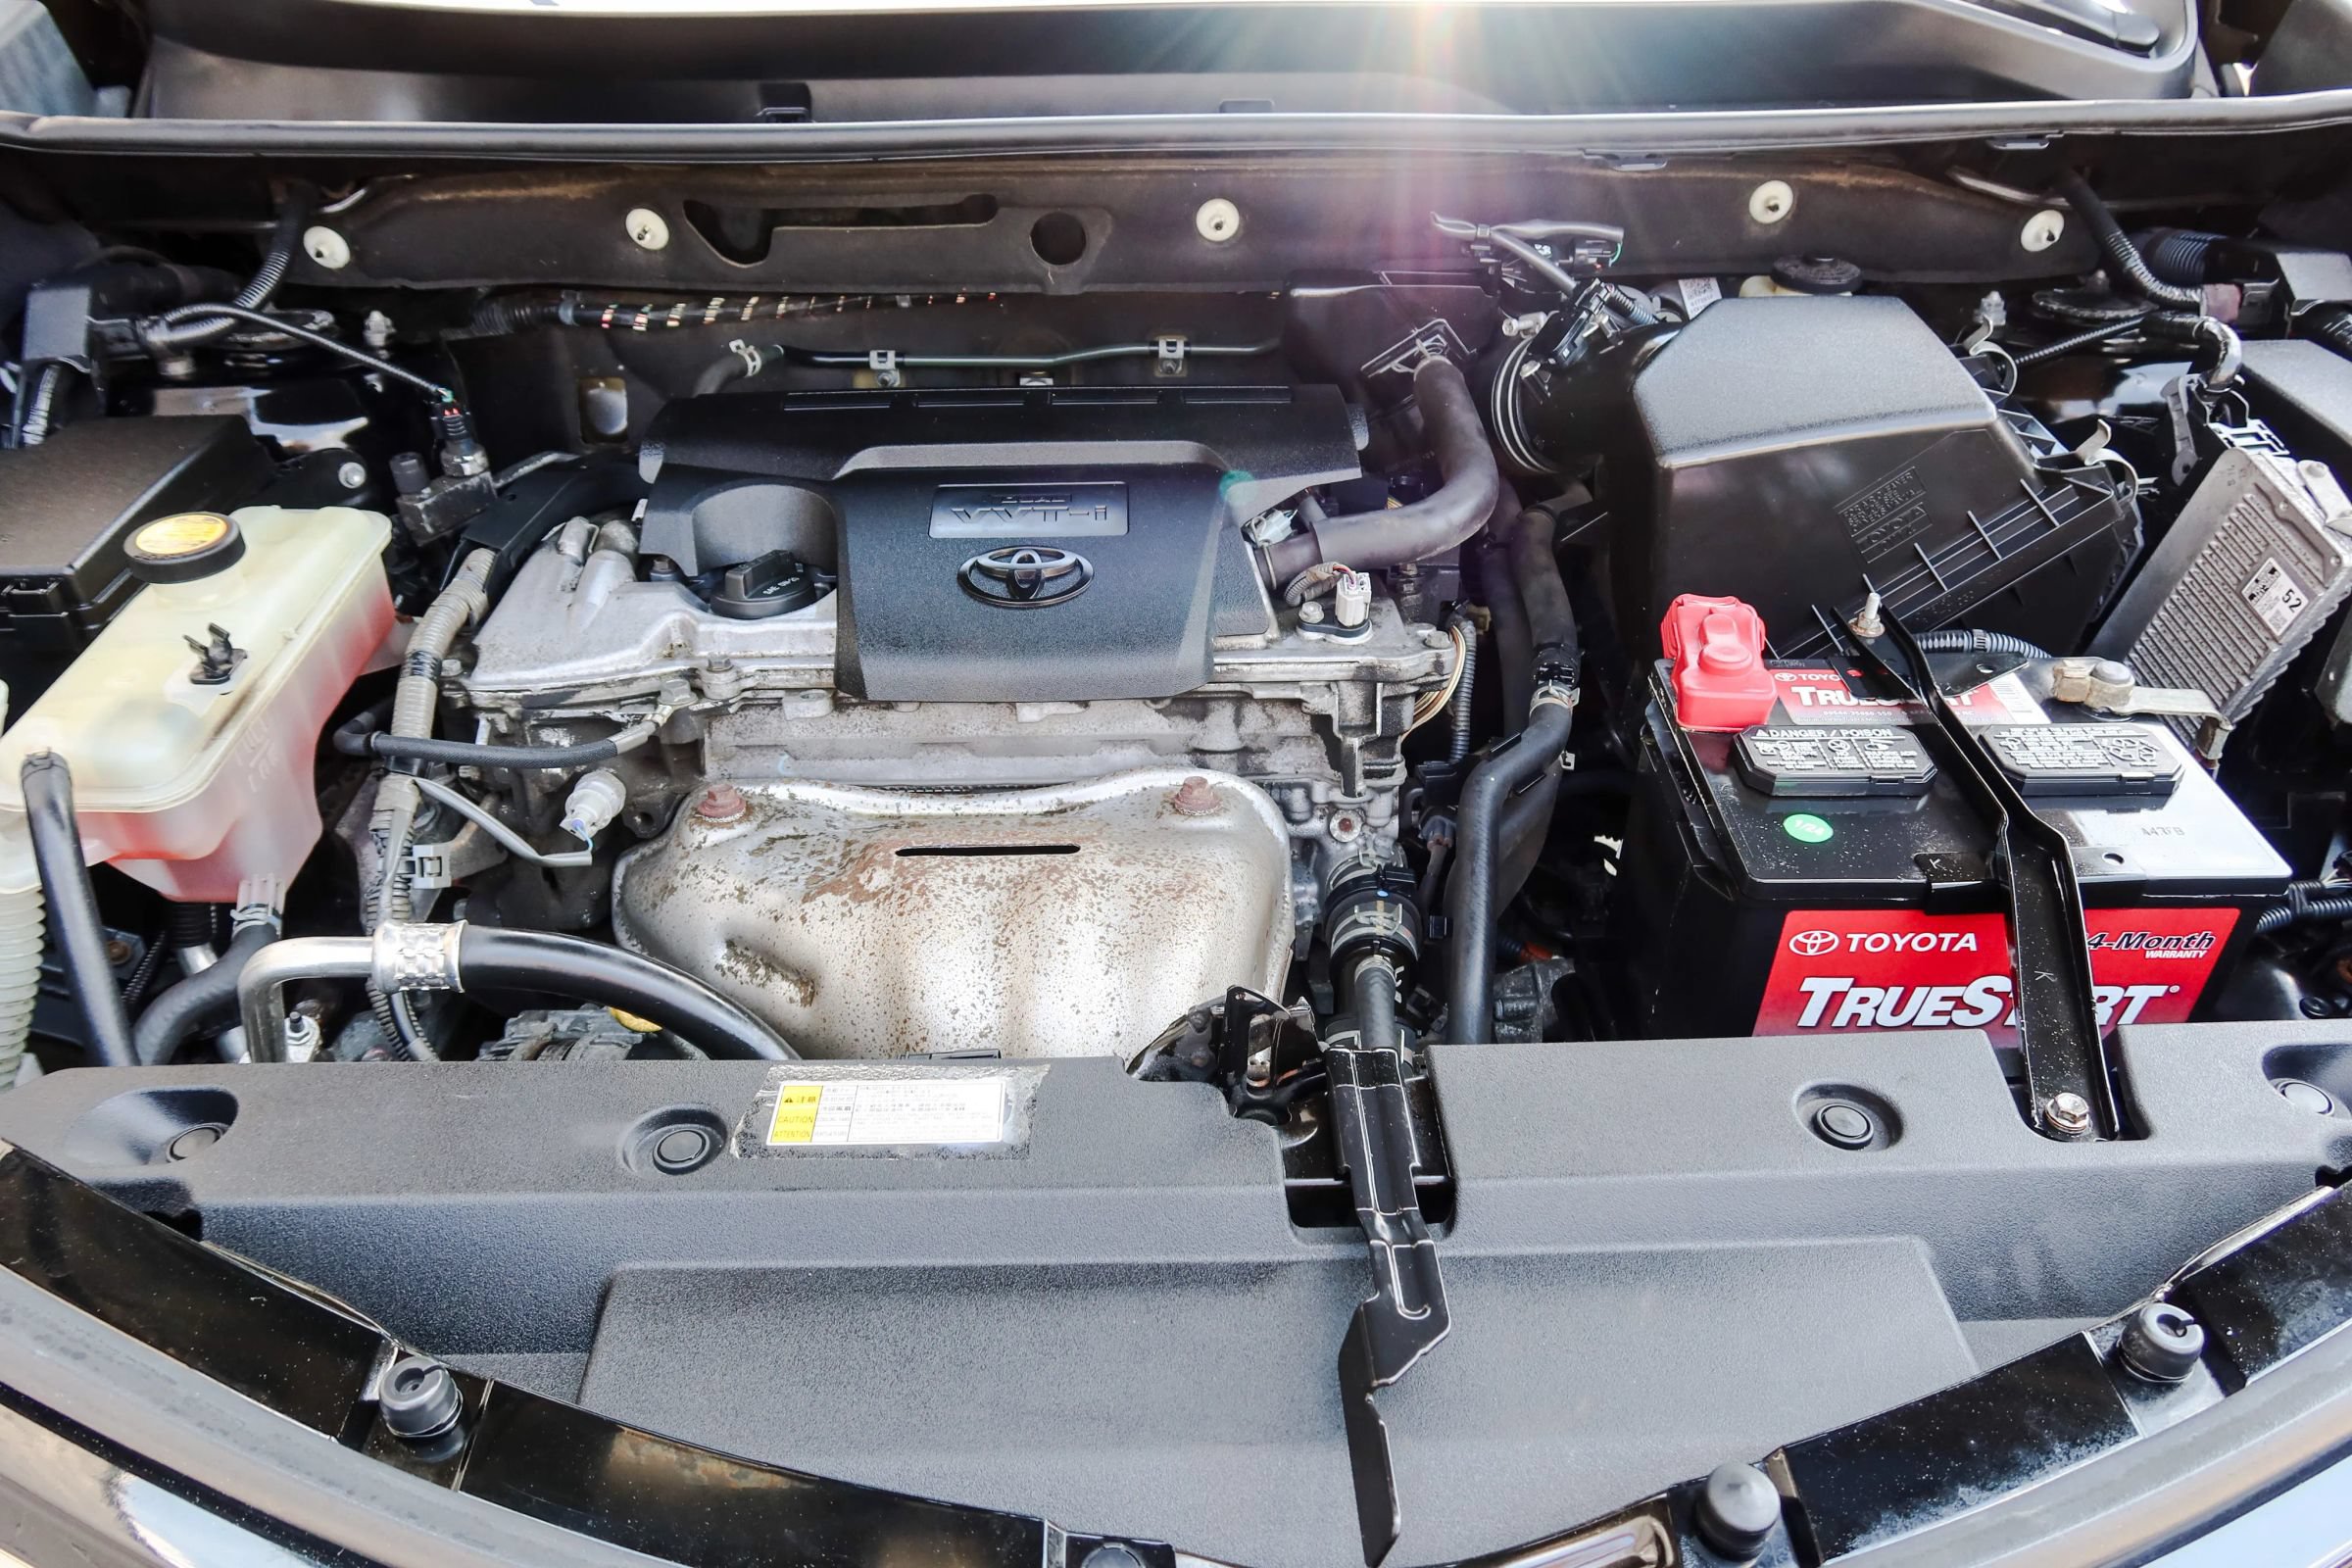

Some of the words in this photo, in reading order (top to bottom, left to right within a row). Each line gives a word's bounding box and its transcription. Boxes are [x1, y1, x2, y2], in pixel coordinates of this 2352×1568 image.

[2281, 588, 2303, 613] 52
[1798, 672, 1842, 681] TOYO
[1768, 728, 1827, 738] DANGER
[1838, 728, 1893, 737] POISON
[1846, 932, 1978, 953] TOYOTA
[2087, 931, 2216, 951] 4-Month
[2144, 950, 2208, 959] WARRANTY
[777, 1115, 813, 1124] CAUTION
